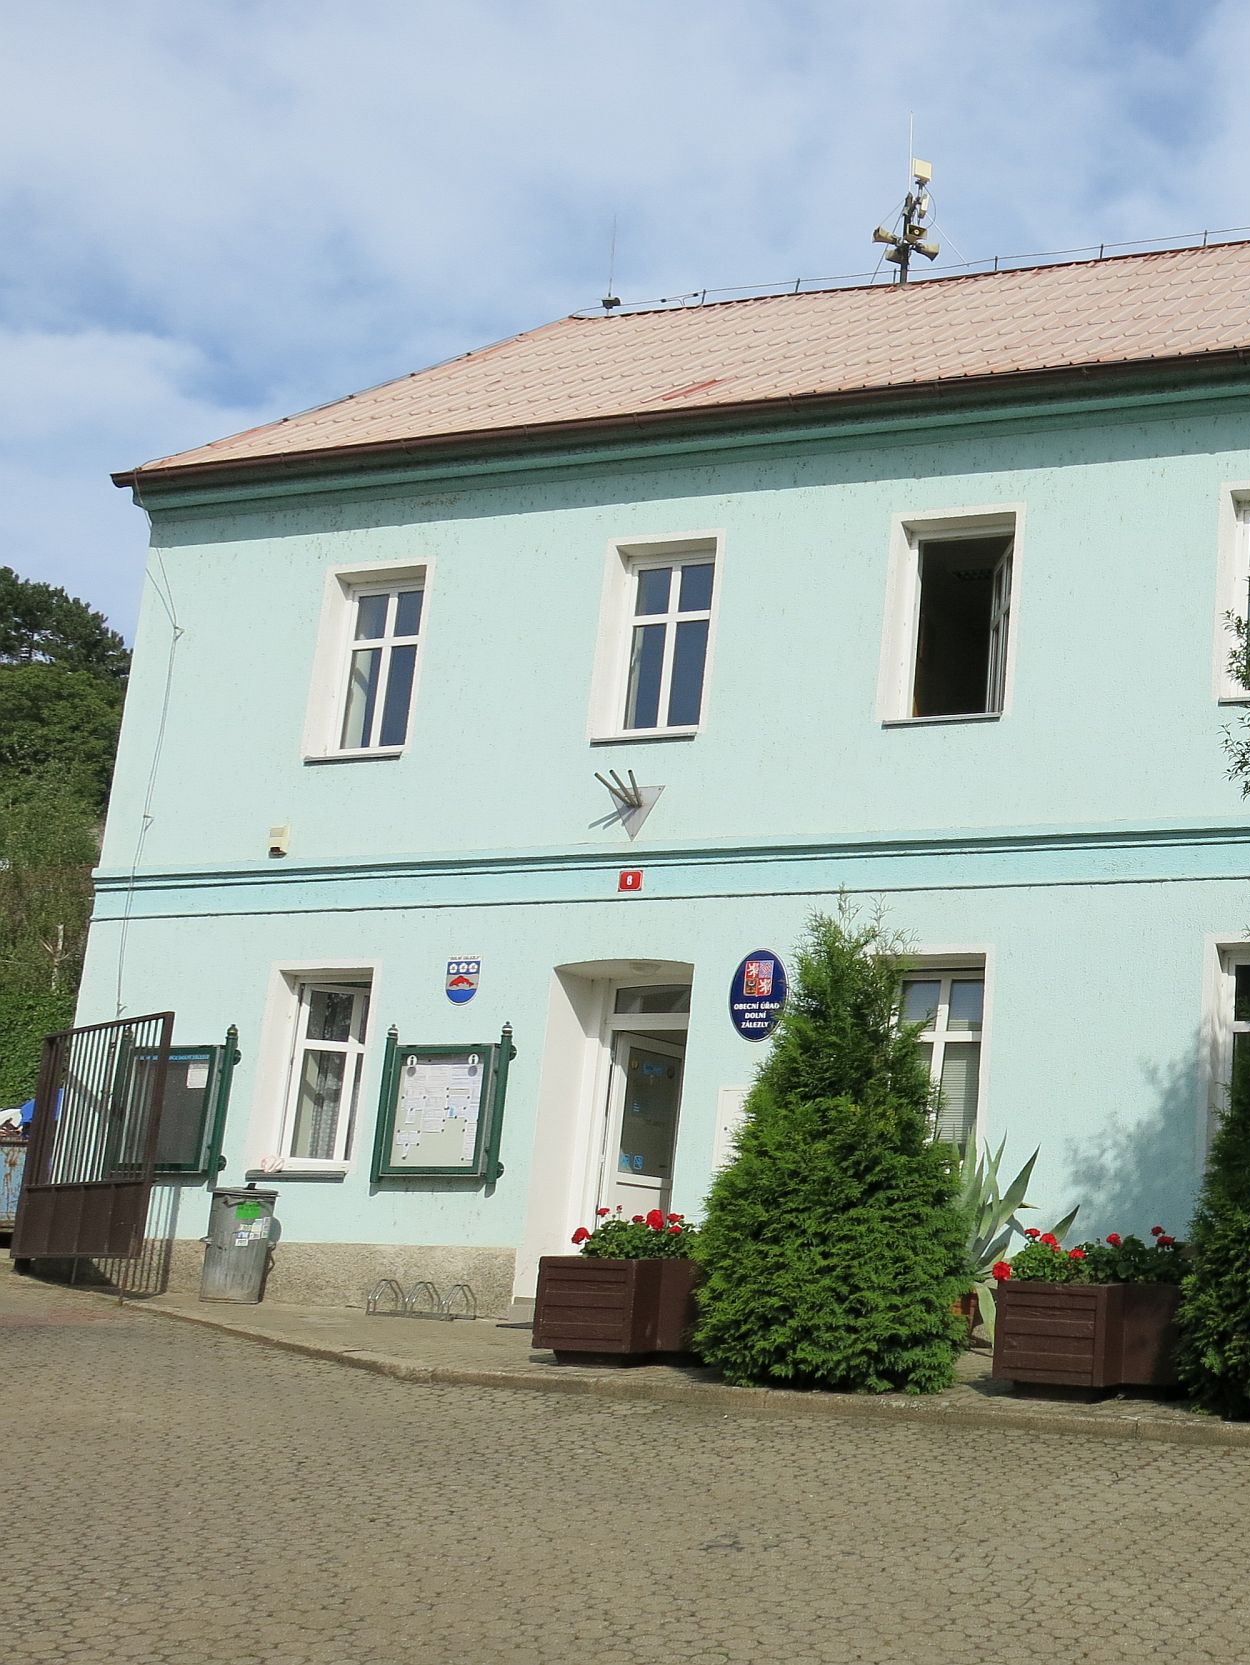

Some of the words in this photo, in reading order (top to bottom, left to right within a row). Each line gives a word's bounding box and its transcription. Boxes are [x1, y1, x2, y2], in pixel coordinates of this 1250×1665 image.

[733, 1001, 759, 1010] OBECNÍ
[760, 1001, 780, 1010] ÚŘAD
[744, 1010, 767, 1019] DOLNÍ
[741, 1020, 769, 1028] ZÁLEZLY
